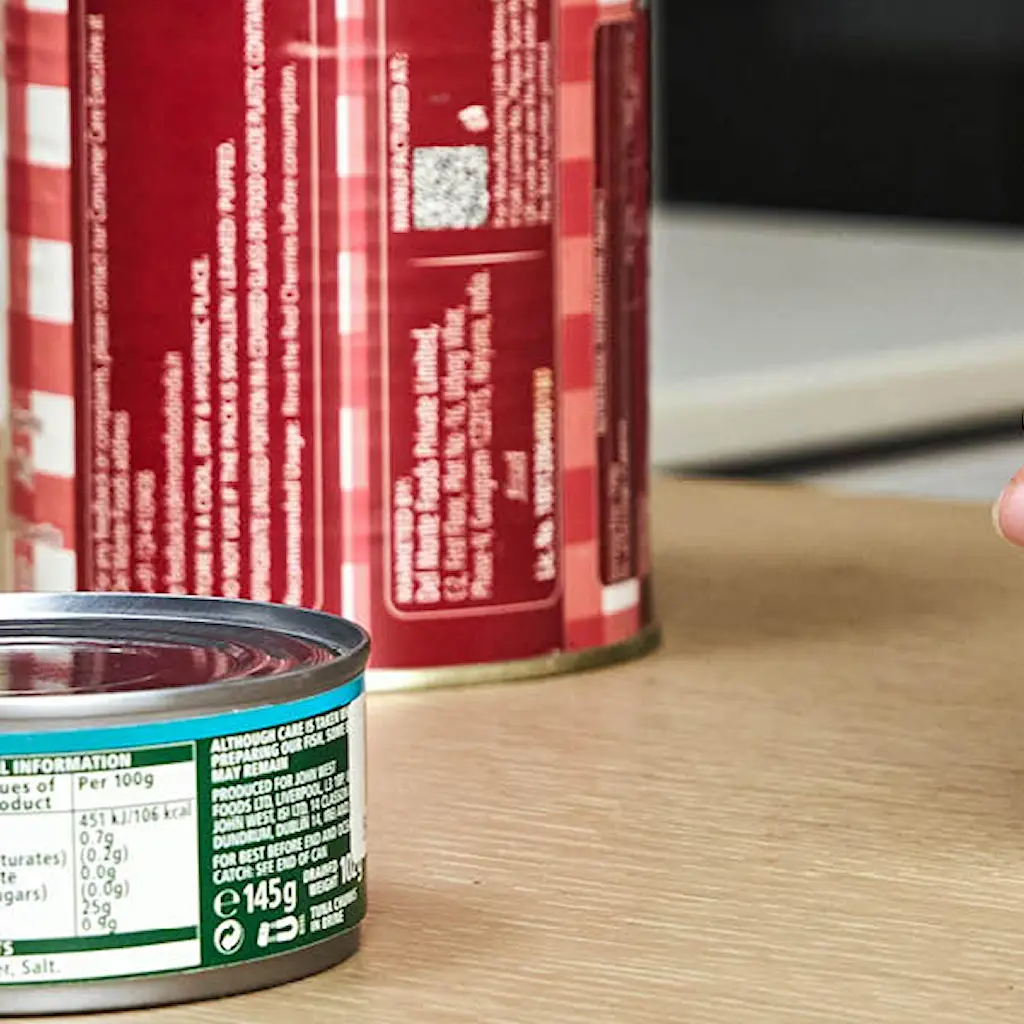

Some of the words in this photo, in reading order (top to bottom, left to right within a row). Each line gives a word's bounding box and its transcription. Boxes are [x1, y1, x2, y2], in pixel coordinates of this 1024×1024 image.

[88, 13, 104, 30] at
[491, 2, 506, 61] Address
[87, 32, 105, 108] Executive
[246, 65, 265, 125] PLASTIC
[83, 110, 107, 144] Care
[391, 85, 409, 233] MANUFACTURED
[492, 97, 507, 200] Manufacturing
[87, 144, 106, 223] Consumer
[279, 177, 298, 235] before
[94, 223, 107, 251] our
[247, 243, 267, 290] GLASS
[281, 236, 299, 304] Cherries
[93, 313, 111, 361] please
[248, 290, 268, 359] COVERED
[281, 304, 299, 339] Red
[193, 316, 210, 401] HYGIENIC
[282, 340, 299, 370] the
[221, 381, 236, 400] IS
[249, 372, 267, 388] IN
[441, 349, 470, 400] Udyog
[194, 401, 210, 417] &
[282, 370, 300, 416] Rinse
[194, 418, 211, 456] DRY
[220, 400, 237, 449] PACK
[249, 389, 268, 456] PORTION
[413, 395, 438, 458] Private
[220, 451, 238, 483] THE
[442, 459, 466, 494] Plot
[221, 486, 238, 504] IF
[249, 456, 269, 516] UNUSED
[413, 458, 439, 513] Foods
[195, 515, 210, 528] A
[221, 506, 238, 539] USE
[195, 530, 210, 548] IN
[394, 508, 413, 603] MARKETED
[416, 513, 439, 570] Monte
[444, 537, 466, 571] First
[222, 541, 239, 577] NOT
[415, 571, 439, 603] Del
[210, 728, 277, 754] ALTHOUGH
[277, 720, 305, 741] CARE
[304, 718, 316, 733] IS
[314, 713, 340, 731] TAKEN
[13, 752, 132, 774] INFORMATION
[210, 742, 280, 768] PREPARING
[280, 738, 304, 755] OUR
[210, 764, 243, 784] MAY
[242, 755, 290, 778] REMAIN
[0, 783, 30, 794] ues
[36, 777, 56, 793] of
[78, 775, 108, 791] Per
[115, 771, 155, 789] 100g
[211, 779, 274, 803] PRODUCED
[273, 774, 294, 792] FOR
[293, 766, 319, 786] JOHN
[0, 796, 52, 811] oduct
[79, 811, 108, 827] 451
[111, 805, 161, 826] kJ/106
[163, 800, 192, 820] kcal
[211, 796, 253, 818] FOODS
[79, 829, 114, 848] 0.7g
[211, 815, 245, 836] JOHN
[274, 816, 311, 838] DUBLIN
[0, 848, 68, 869] turates)
[80, 844, 130, 866] (0.2g)
[212, 852, 238, 870] FOR
[237, 845, 267, 865] BEST
[266, 836, 304, 859] BEFORE
[303, 831, 322, 850] END
[254, 858, 276, 877] SEE
[275, 854, 298, 873] END
[297, 850, 312, 867] OF
[310, 843, 329, 863] CAN
[81, 864, 117, 882] 0.0g
[303, 858, 340, 884] DRAINED
[307, 873, 340, 898] WEIGHT
[81, 879, 131, 900] (0.0g)
[243, 876, 298, 914] 145g
[82, 898, 113, 917] 25g
[310, 899, 334, 920] TUNA
[310, 918, 322, 933] IN
[321, 908, 345, 930] BRINE
[21, 957, 61, 976] Salt.
